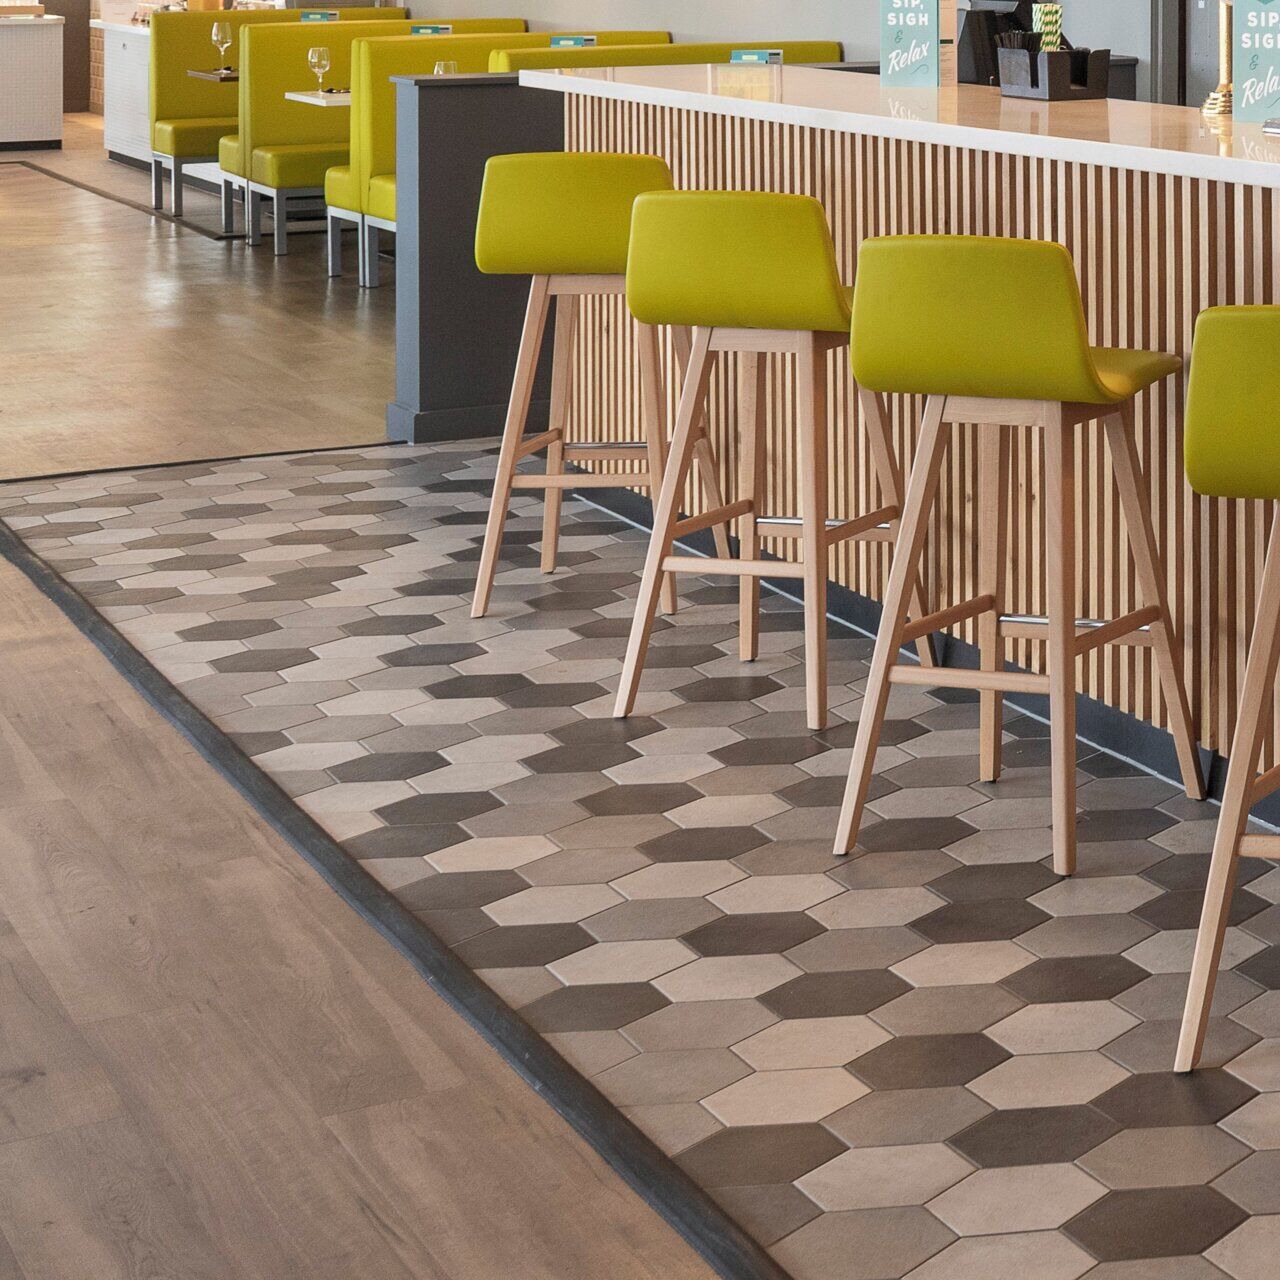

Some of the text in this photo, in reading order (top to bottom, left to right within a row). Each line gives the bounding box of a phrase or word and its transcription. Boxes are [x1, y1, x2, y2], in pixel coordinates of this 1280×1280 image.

[887, 12, 928, 26] SIGH
[895, 30, 903, 44] &
[888, 39, 930, 75] Relax
[1250, 54, 1258, 71] &
